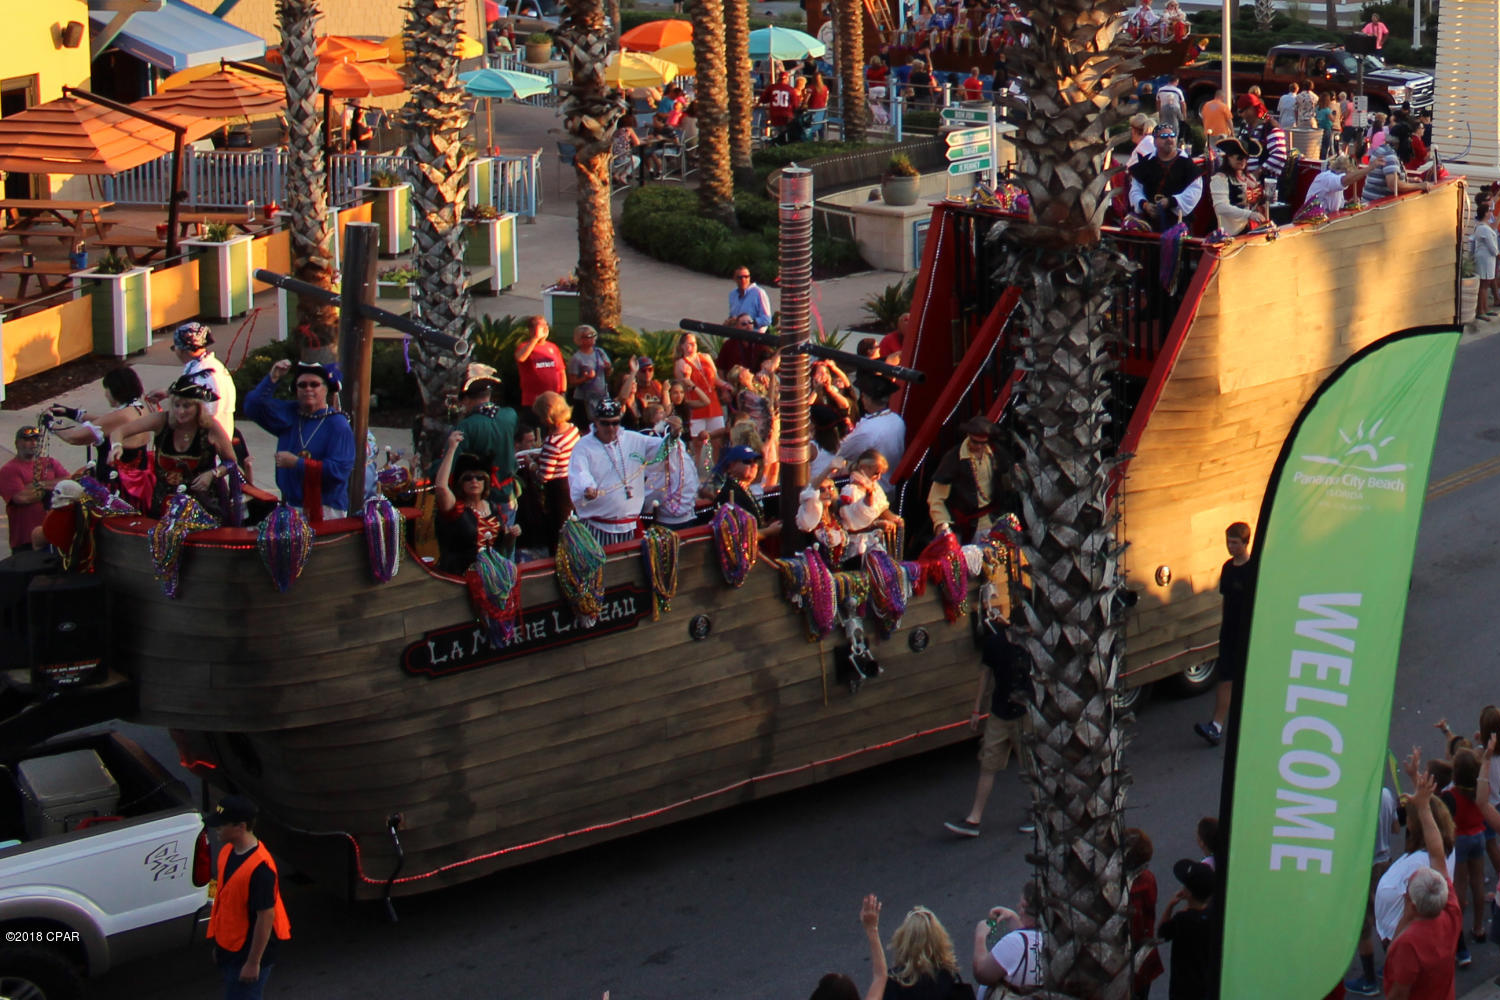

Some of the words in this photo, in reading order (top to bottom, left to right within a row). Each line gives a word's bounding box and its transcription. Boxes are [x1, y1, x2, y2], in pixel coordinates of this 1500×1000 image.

[772, 90, 789, 107] 30
[1293, 471, 1340, 486] Panama
[1341, 473, 1366, 491] City
[1367, 476, 1405, 493] Beach
[428, 638, 464, 666] LA
[471, 618, 547, 656] MRIE
[552, 596, 637, 635] LEAU
[1269, 592, 1363, 875] WELCOME
